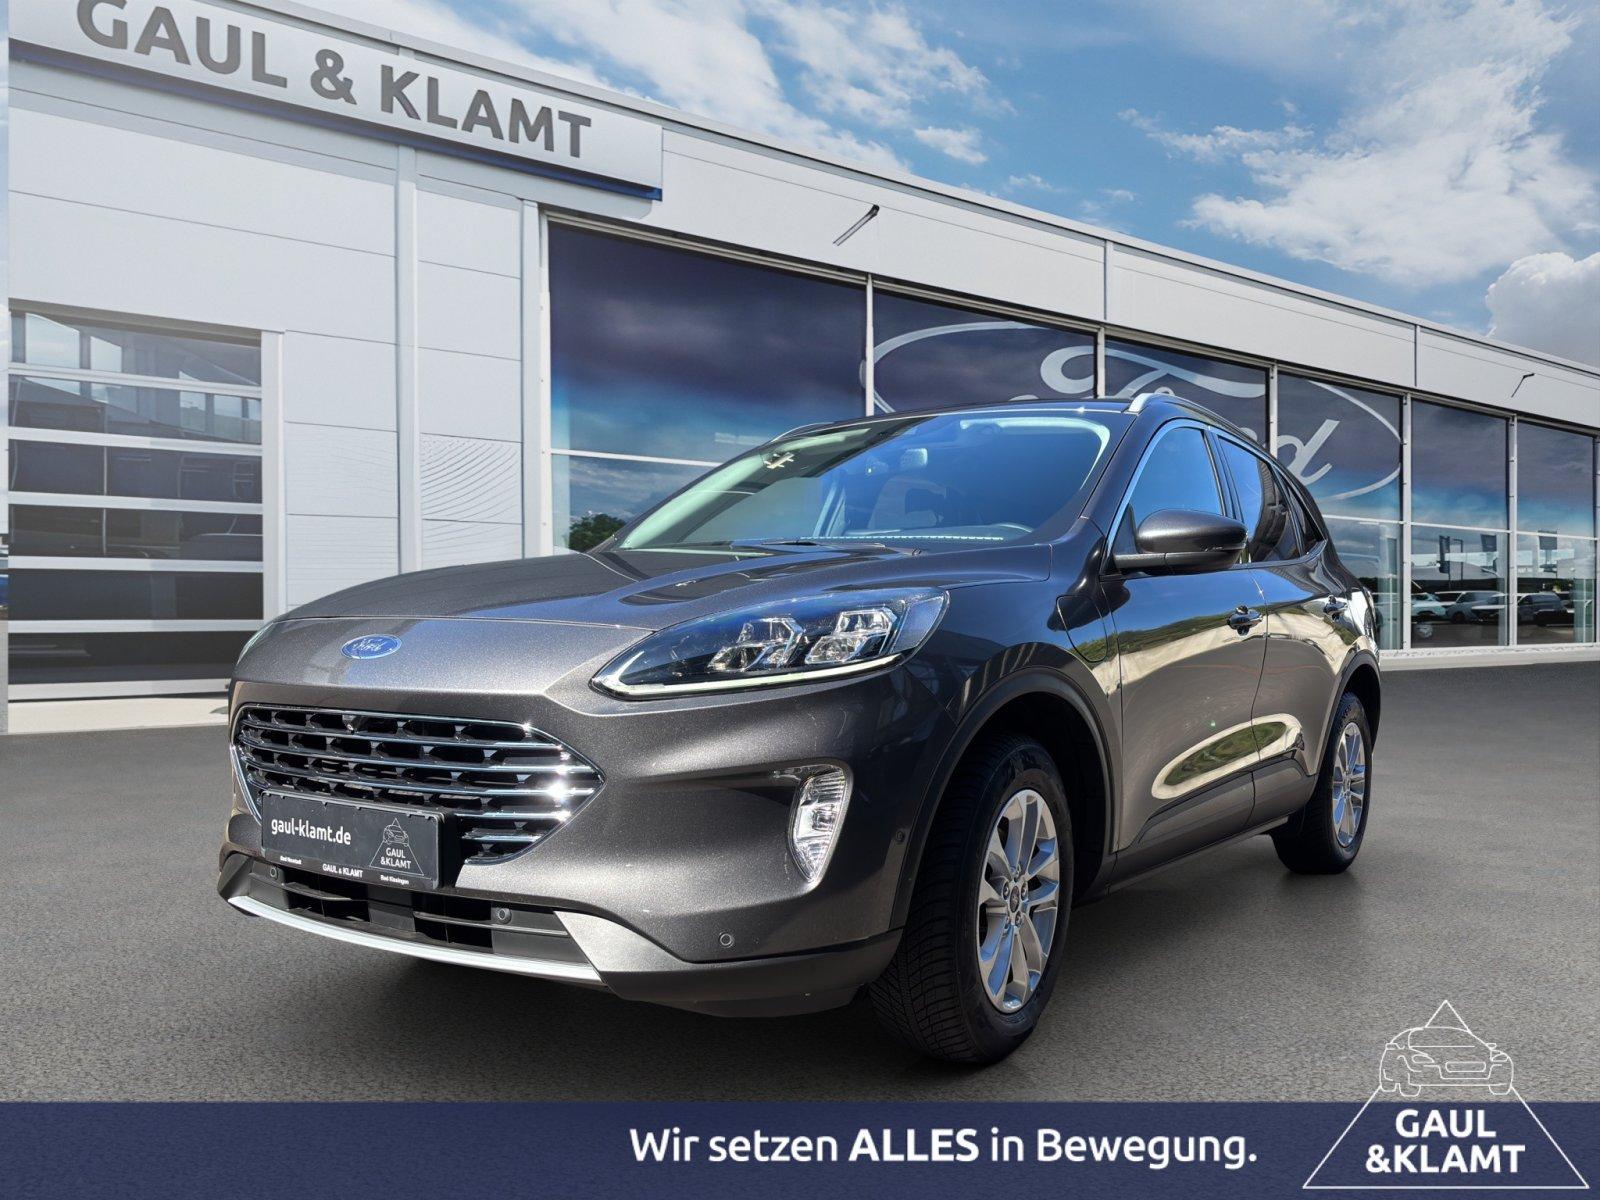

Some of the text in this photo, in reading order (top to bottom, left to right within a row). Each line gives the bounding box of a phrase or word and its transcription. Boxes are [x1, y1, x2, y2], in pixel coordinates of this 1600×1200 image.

[77, 0, 592, 158] GAUL & KLAMT
[271, 817, 351, 845] gaul-klamt.de
[385, 847, 405, 859] GAUL
[322, 863, 337, 874] GAUL
[343, 867, 363, 878] KLAMT
[380, 857, 412, 870] &KLAMT
